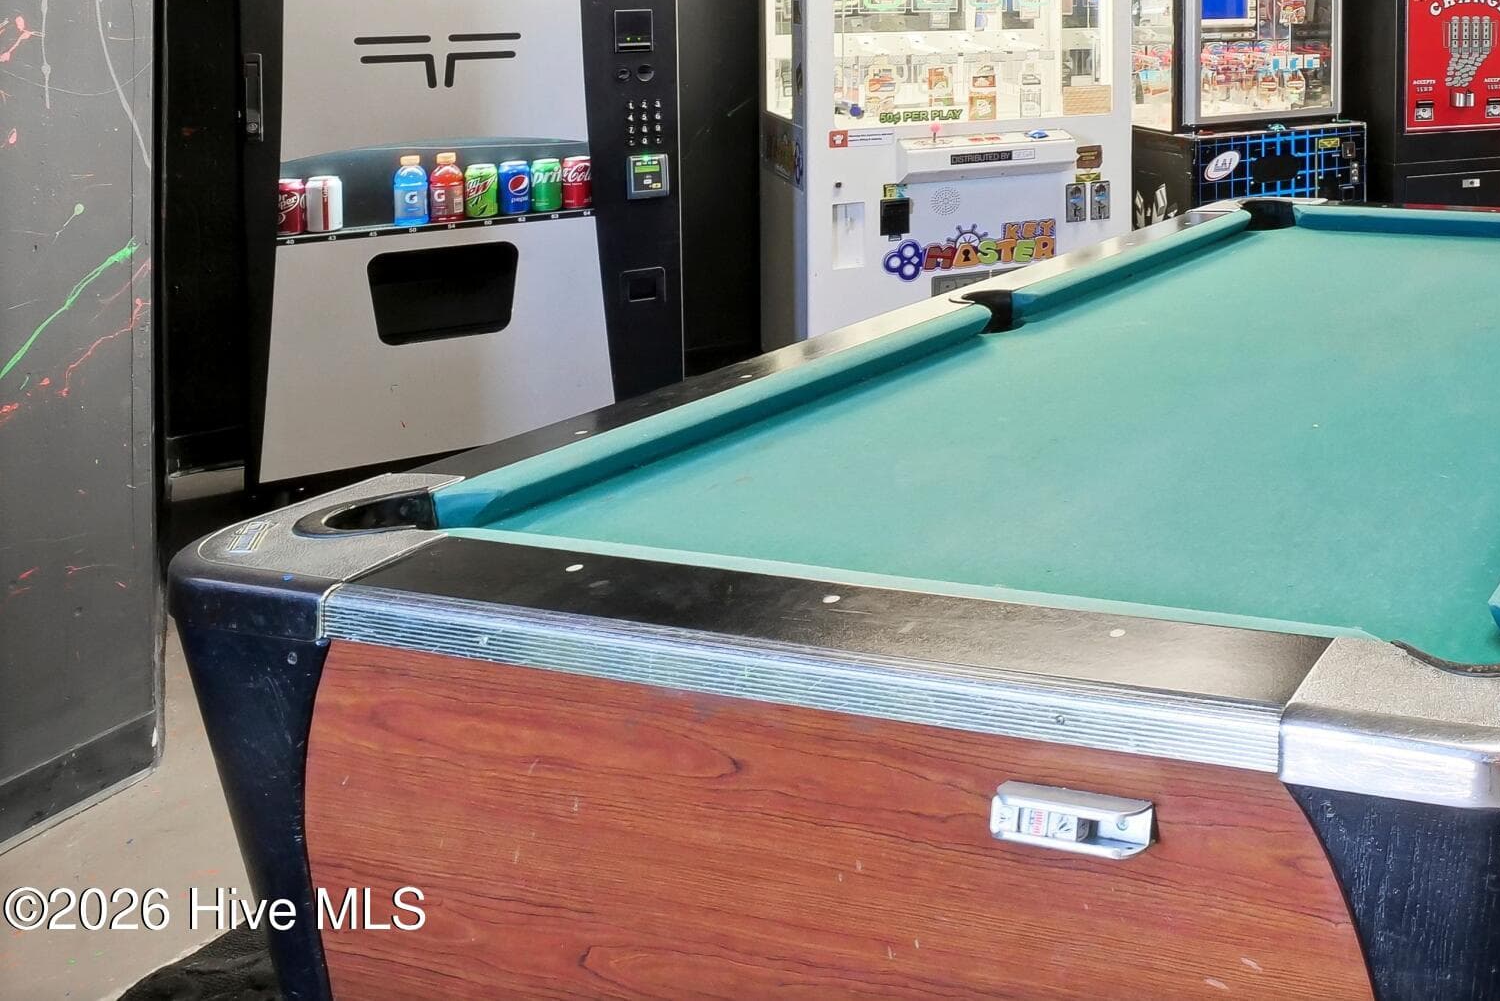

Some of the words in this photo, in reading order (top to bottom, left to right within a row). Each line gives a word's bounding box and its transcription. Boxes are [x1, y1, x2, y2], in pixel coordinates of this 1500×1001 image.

[878, 112, 900, 124] 50¢
[903, 111, 928, 122] PER
[930, 109, 963, 121] PLAY
[952, 152, 999, 164] DISTRIBUTED
[531, 166, 562, 187] prit
[405, 191, 418, 204] G
[434, 190, 445, 202] G
[1003, 218, 1056, 240] KEY
[923, 234, 1056, 272] MASTER
